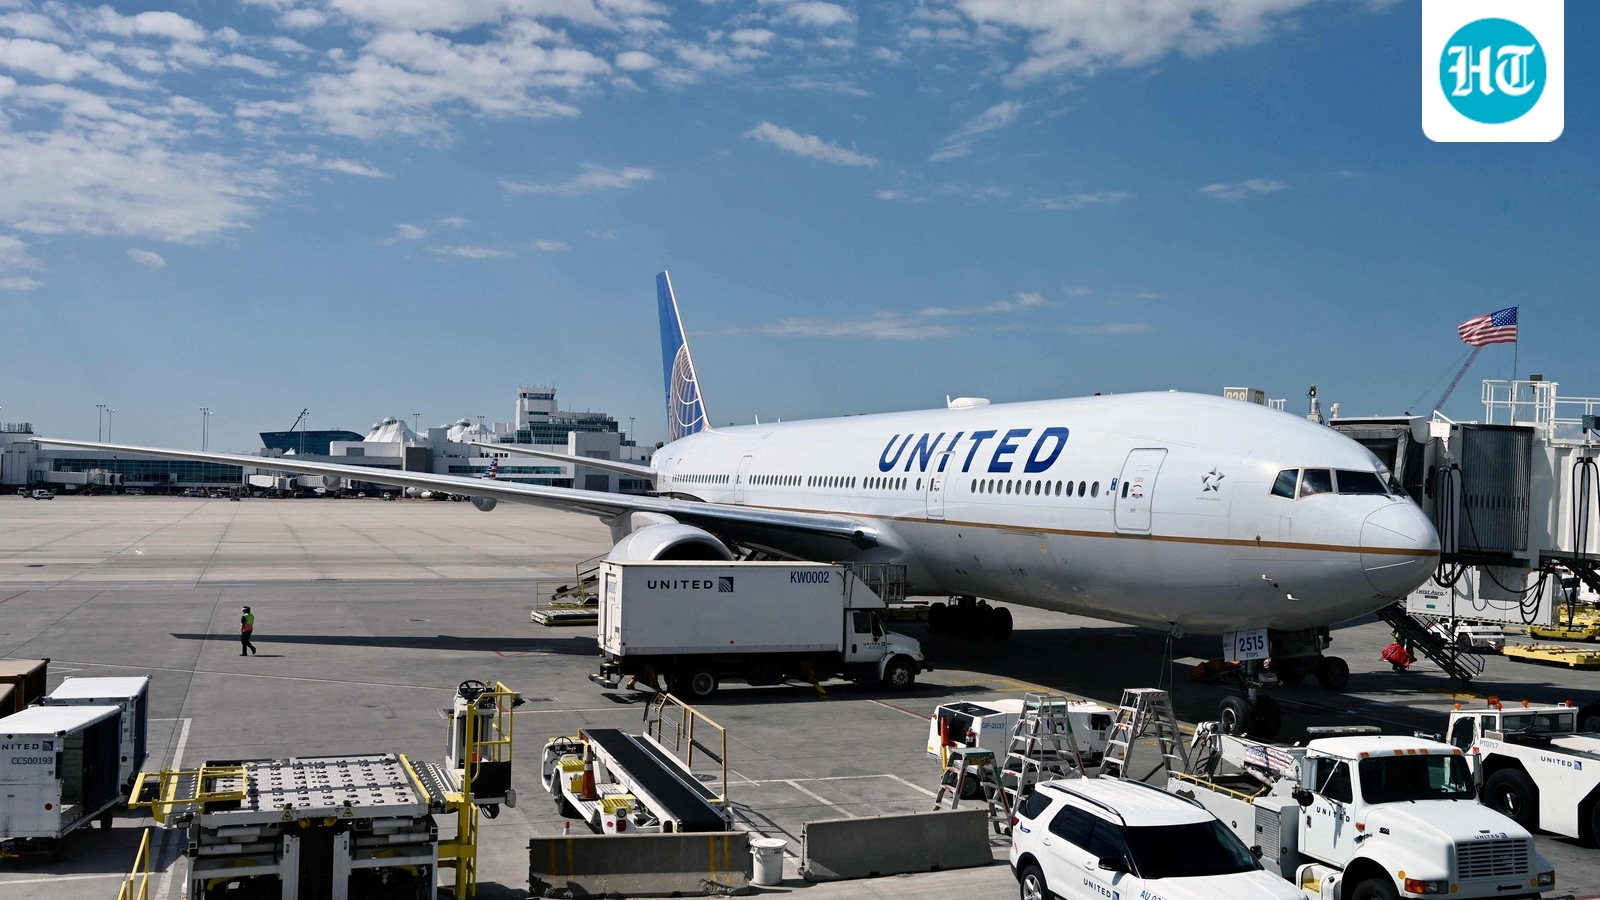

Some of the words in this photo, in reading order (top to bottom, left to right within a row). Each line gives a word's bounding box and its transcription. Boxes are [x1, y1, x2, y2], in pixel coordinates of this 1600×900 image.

[878, 426, 1070, 473] UNITED
[790, 571, 830, 584] KW0002
[647, 580, 714, 590] UNITED
[1238, 635, 1264, 652] 2515
[1479, 739, 1499, 749] PT0717
[11, 756, 53, 765] CC500193
[1540, 755, 1572, 767] UNITED
[1316, 806, 1350, 823] UNITED
[1083, 878, 1111, 898] UNITED
[1139, 889, 1151, 900] AU
